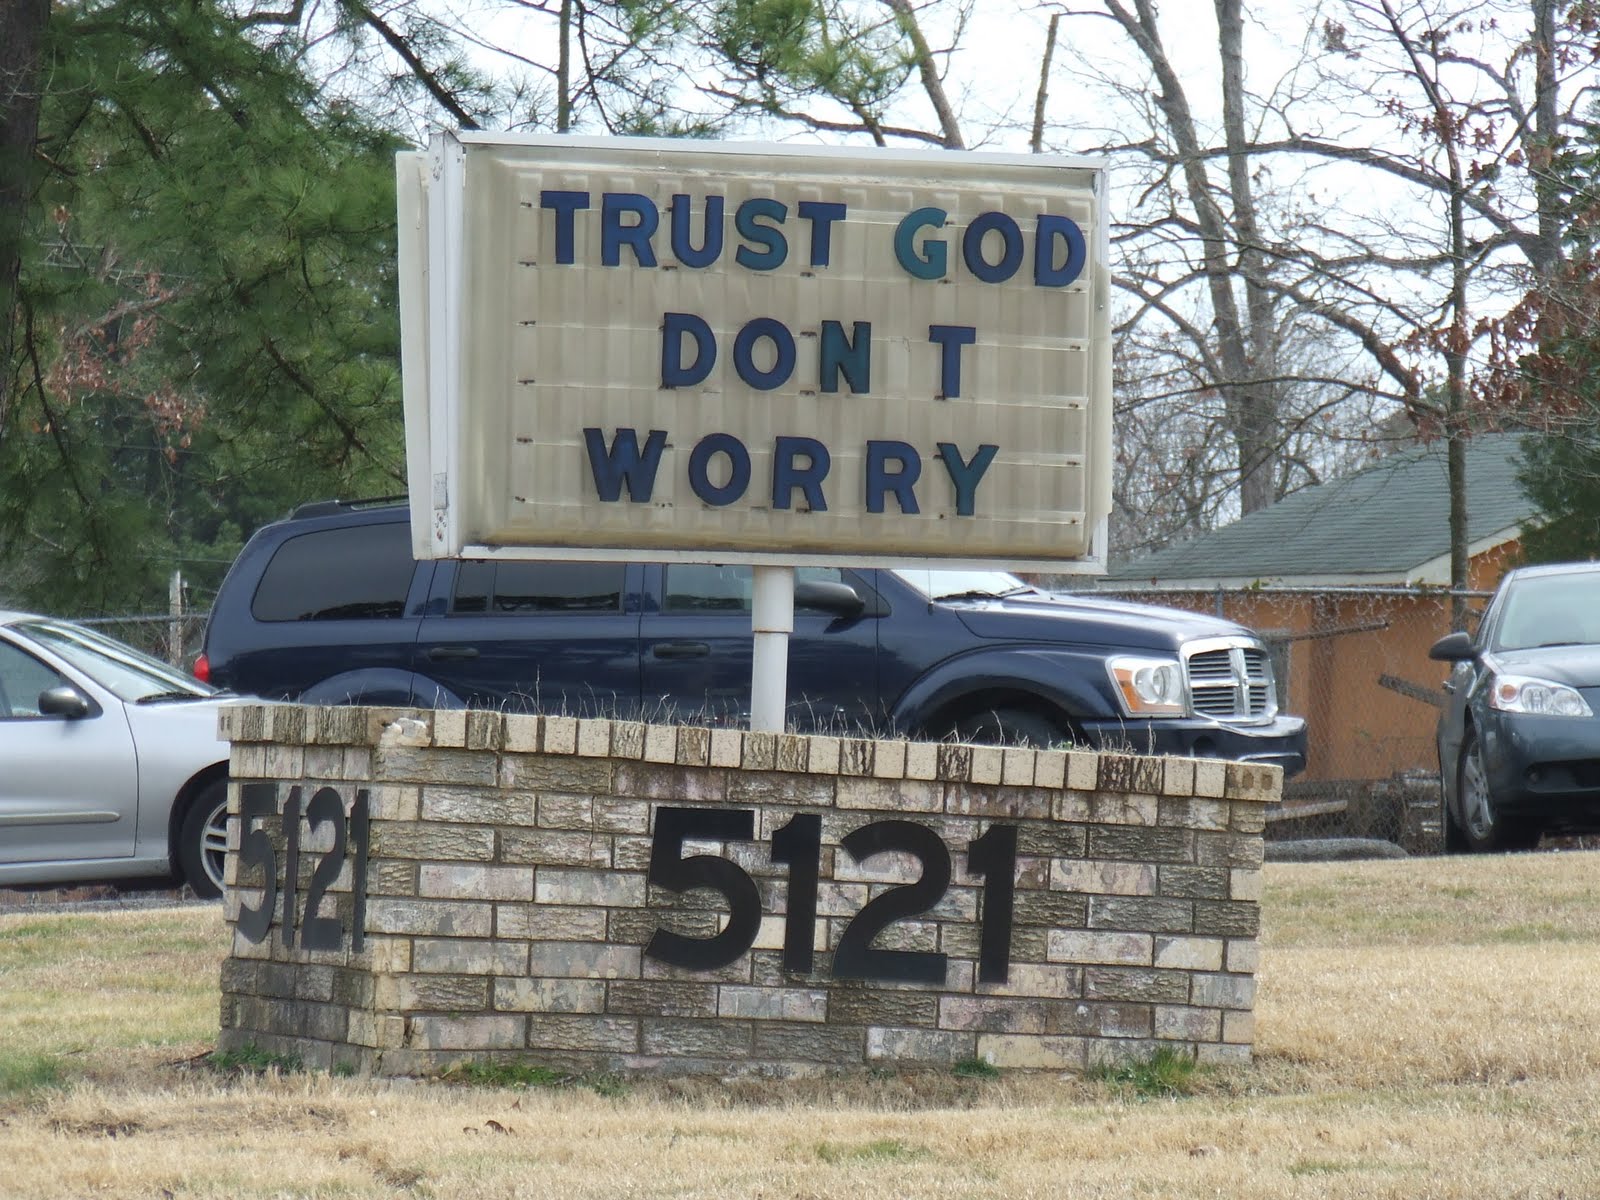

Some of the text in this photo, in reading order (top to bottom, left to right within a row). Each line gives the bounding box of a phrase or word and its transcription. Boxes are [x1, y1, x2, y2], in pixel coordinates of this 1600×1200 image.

[540, 190, 1087, 287] TRUST GOD
[582, 427, 1000, 516] WORRY
[237, 783, 370, 954] 5121
[644, 806, 1017, 984] 5121
